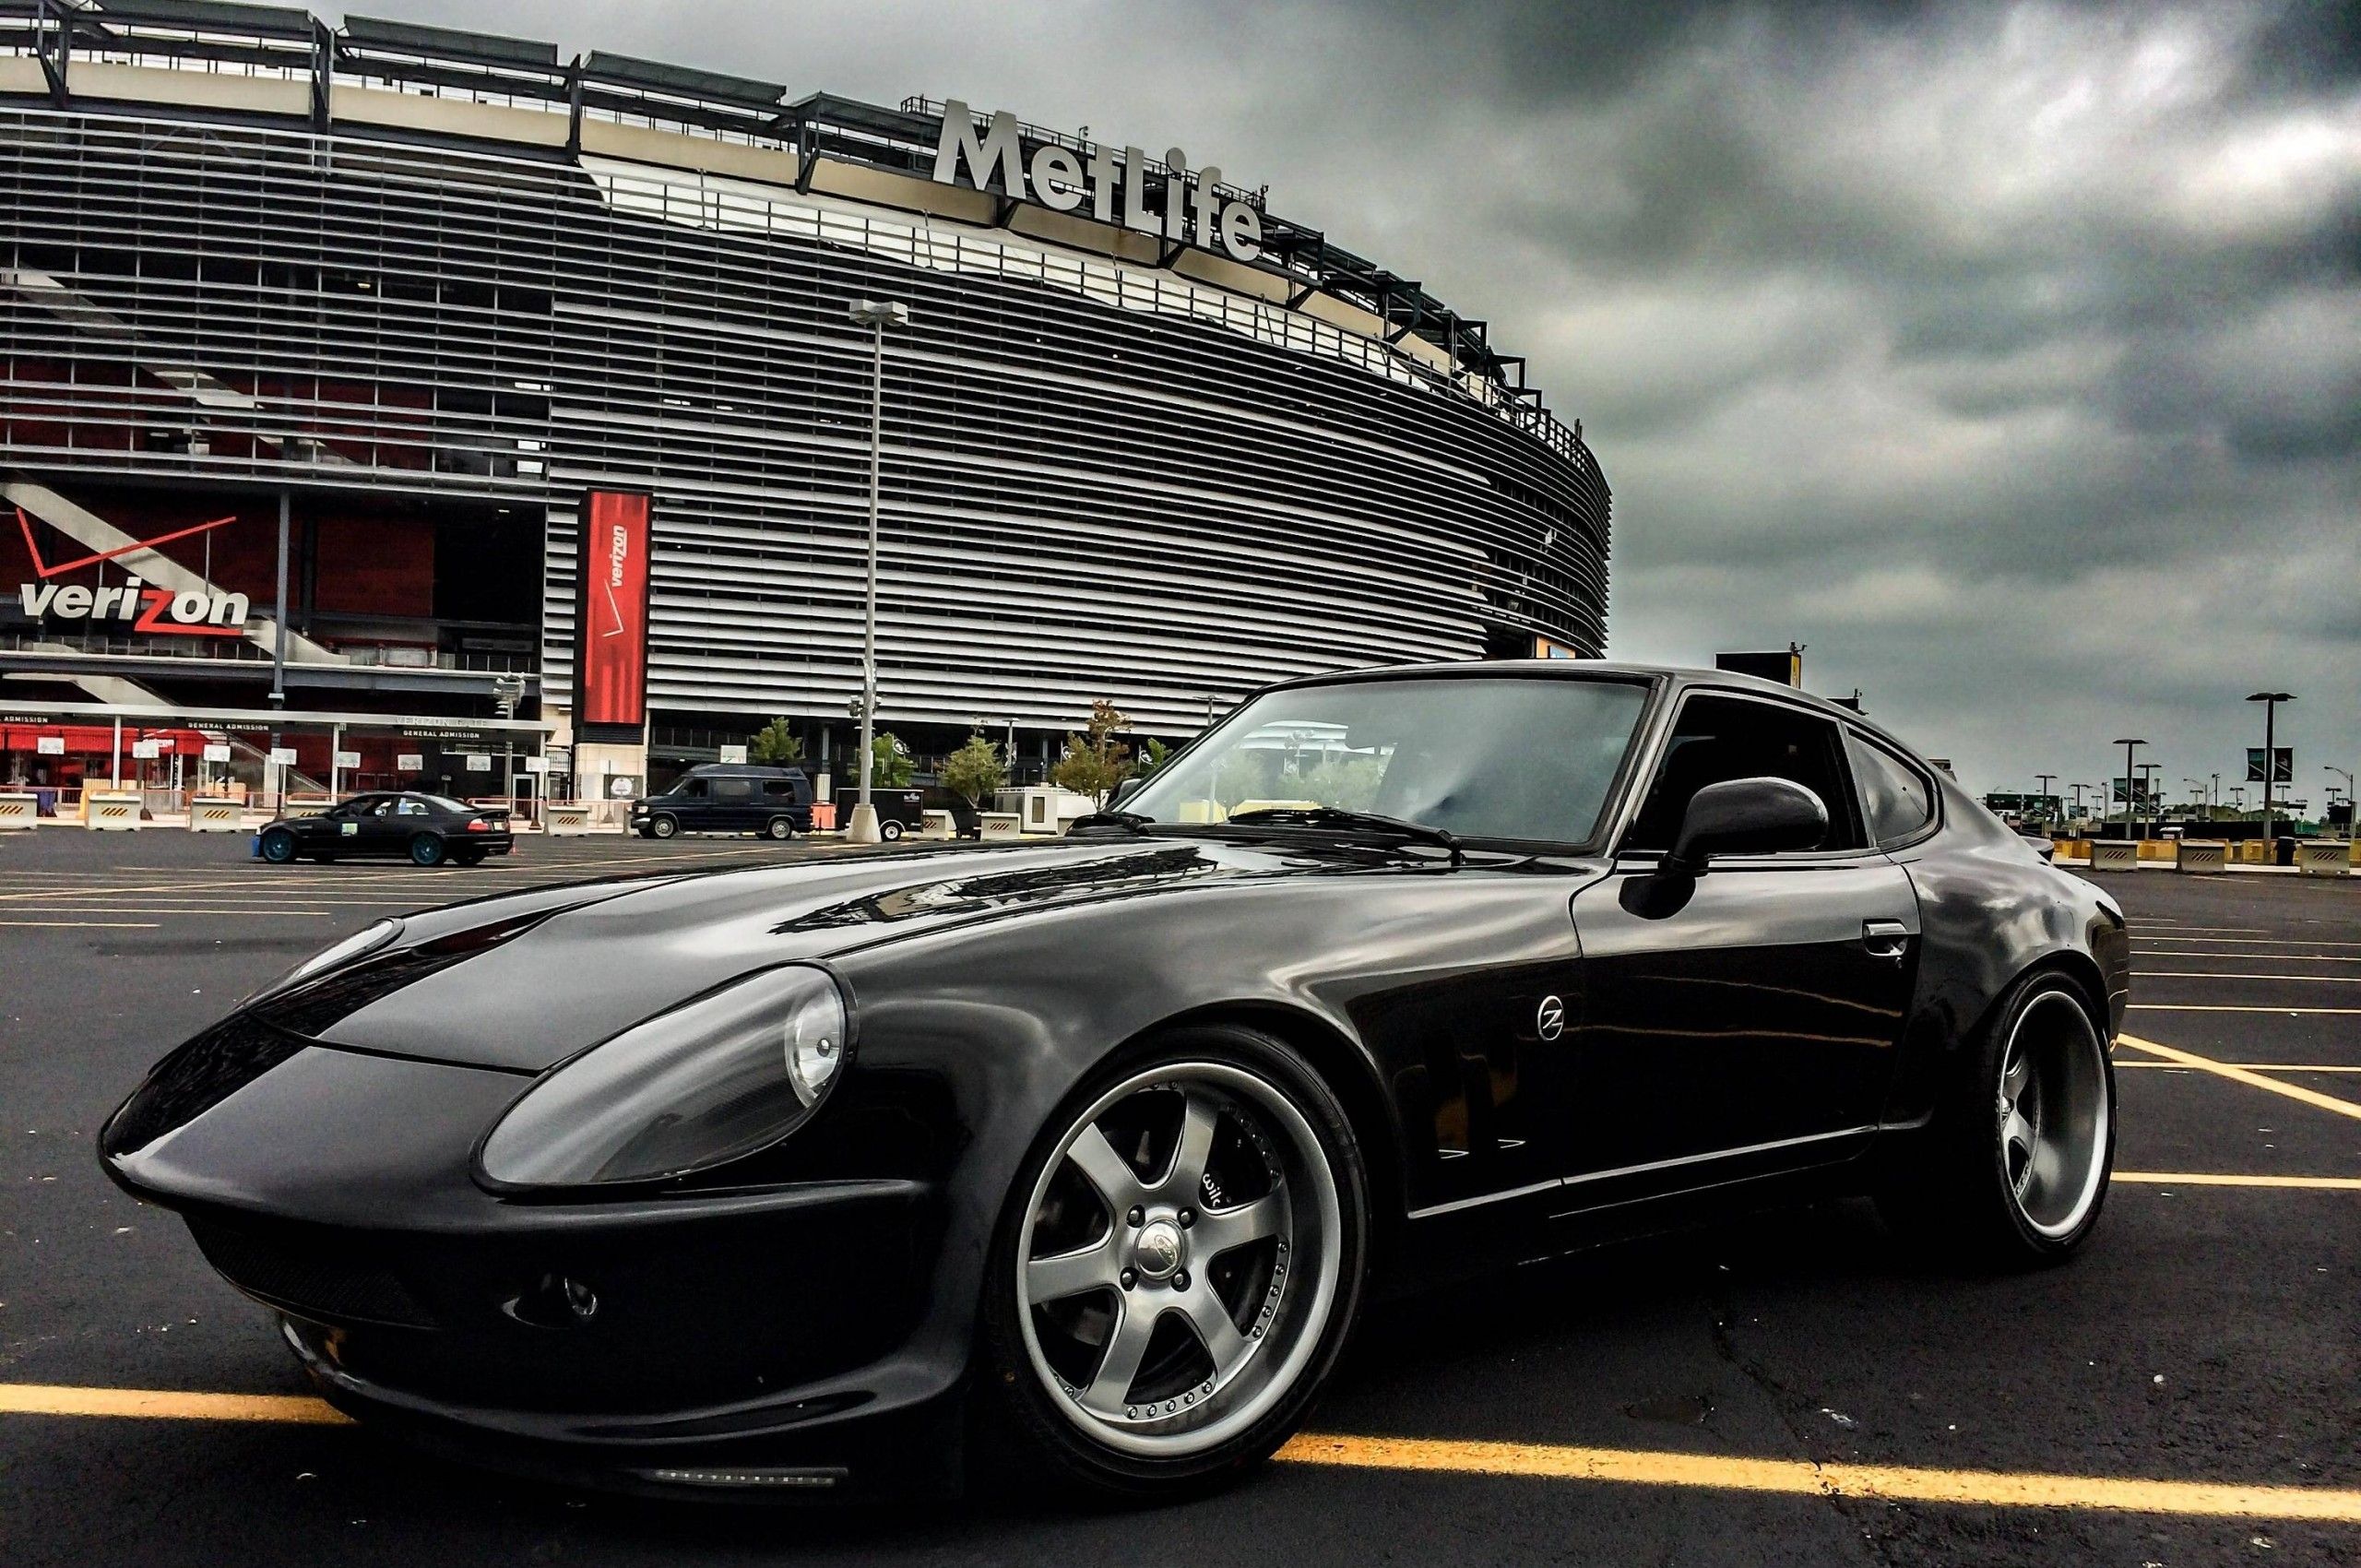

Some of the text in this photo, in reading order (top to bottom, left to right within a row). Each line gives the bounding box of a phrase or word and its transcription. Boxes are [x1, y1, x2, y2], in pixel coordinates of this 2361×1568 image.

[933, 99, 1262, 261] MetLife
[609, 525, 627, 588] verizon
[21, 576, 249, 636] verizon
[456, 719, 487, 728] GTE
